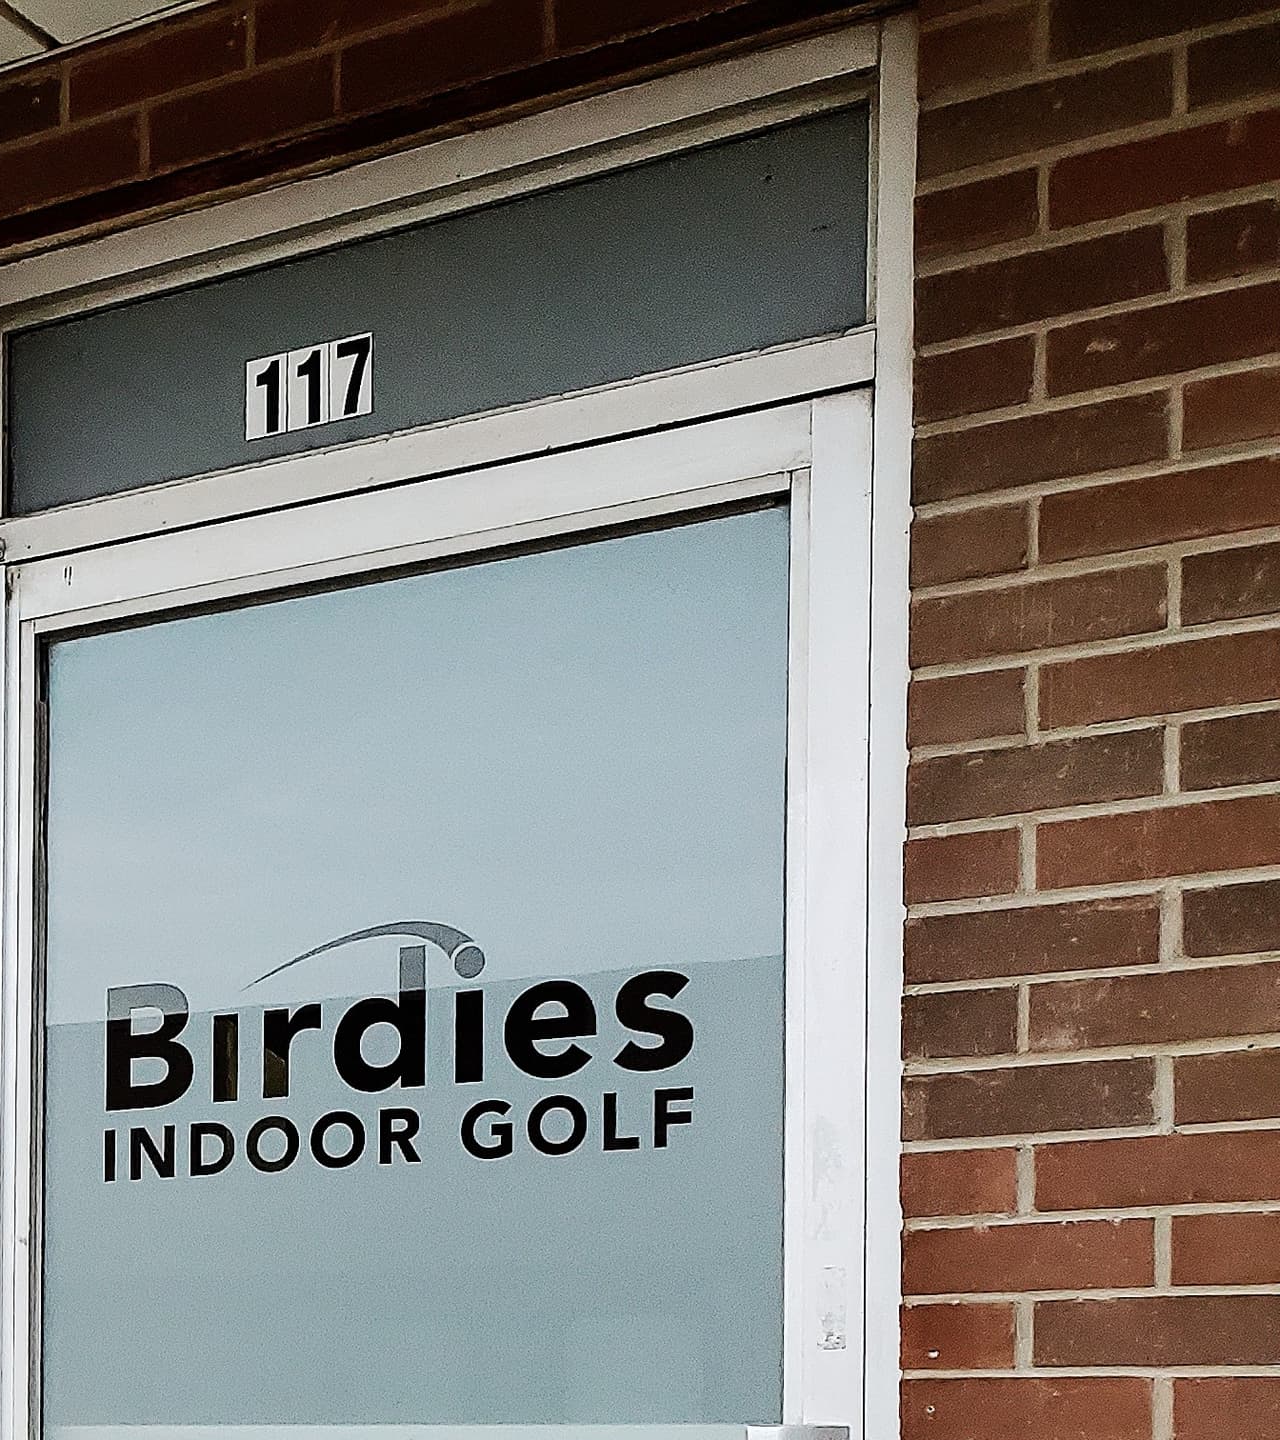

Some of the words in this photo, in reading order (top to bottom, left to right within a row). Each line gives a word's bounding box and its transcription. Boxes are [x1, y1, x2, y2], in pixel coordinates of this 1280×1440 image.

[256, 336, 371, 434] 117
[105, 941, 695, 1112] Birdies
[103, 1108, 422, 1184] INDOOR
[460, 1086, 695, 1160] GOLF
